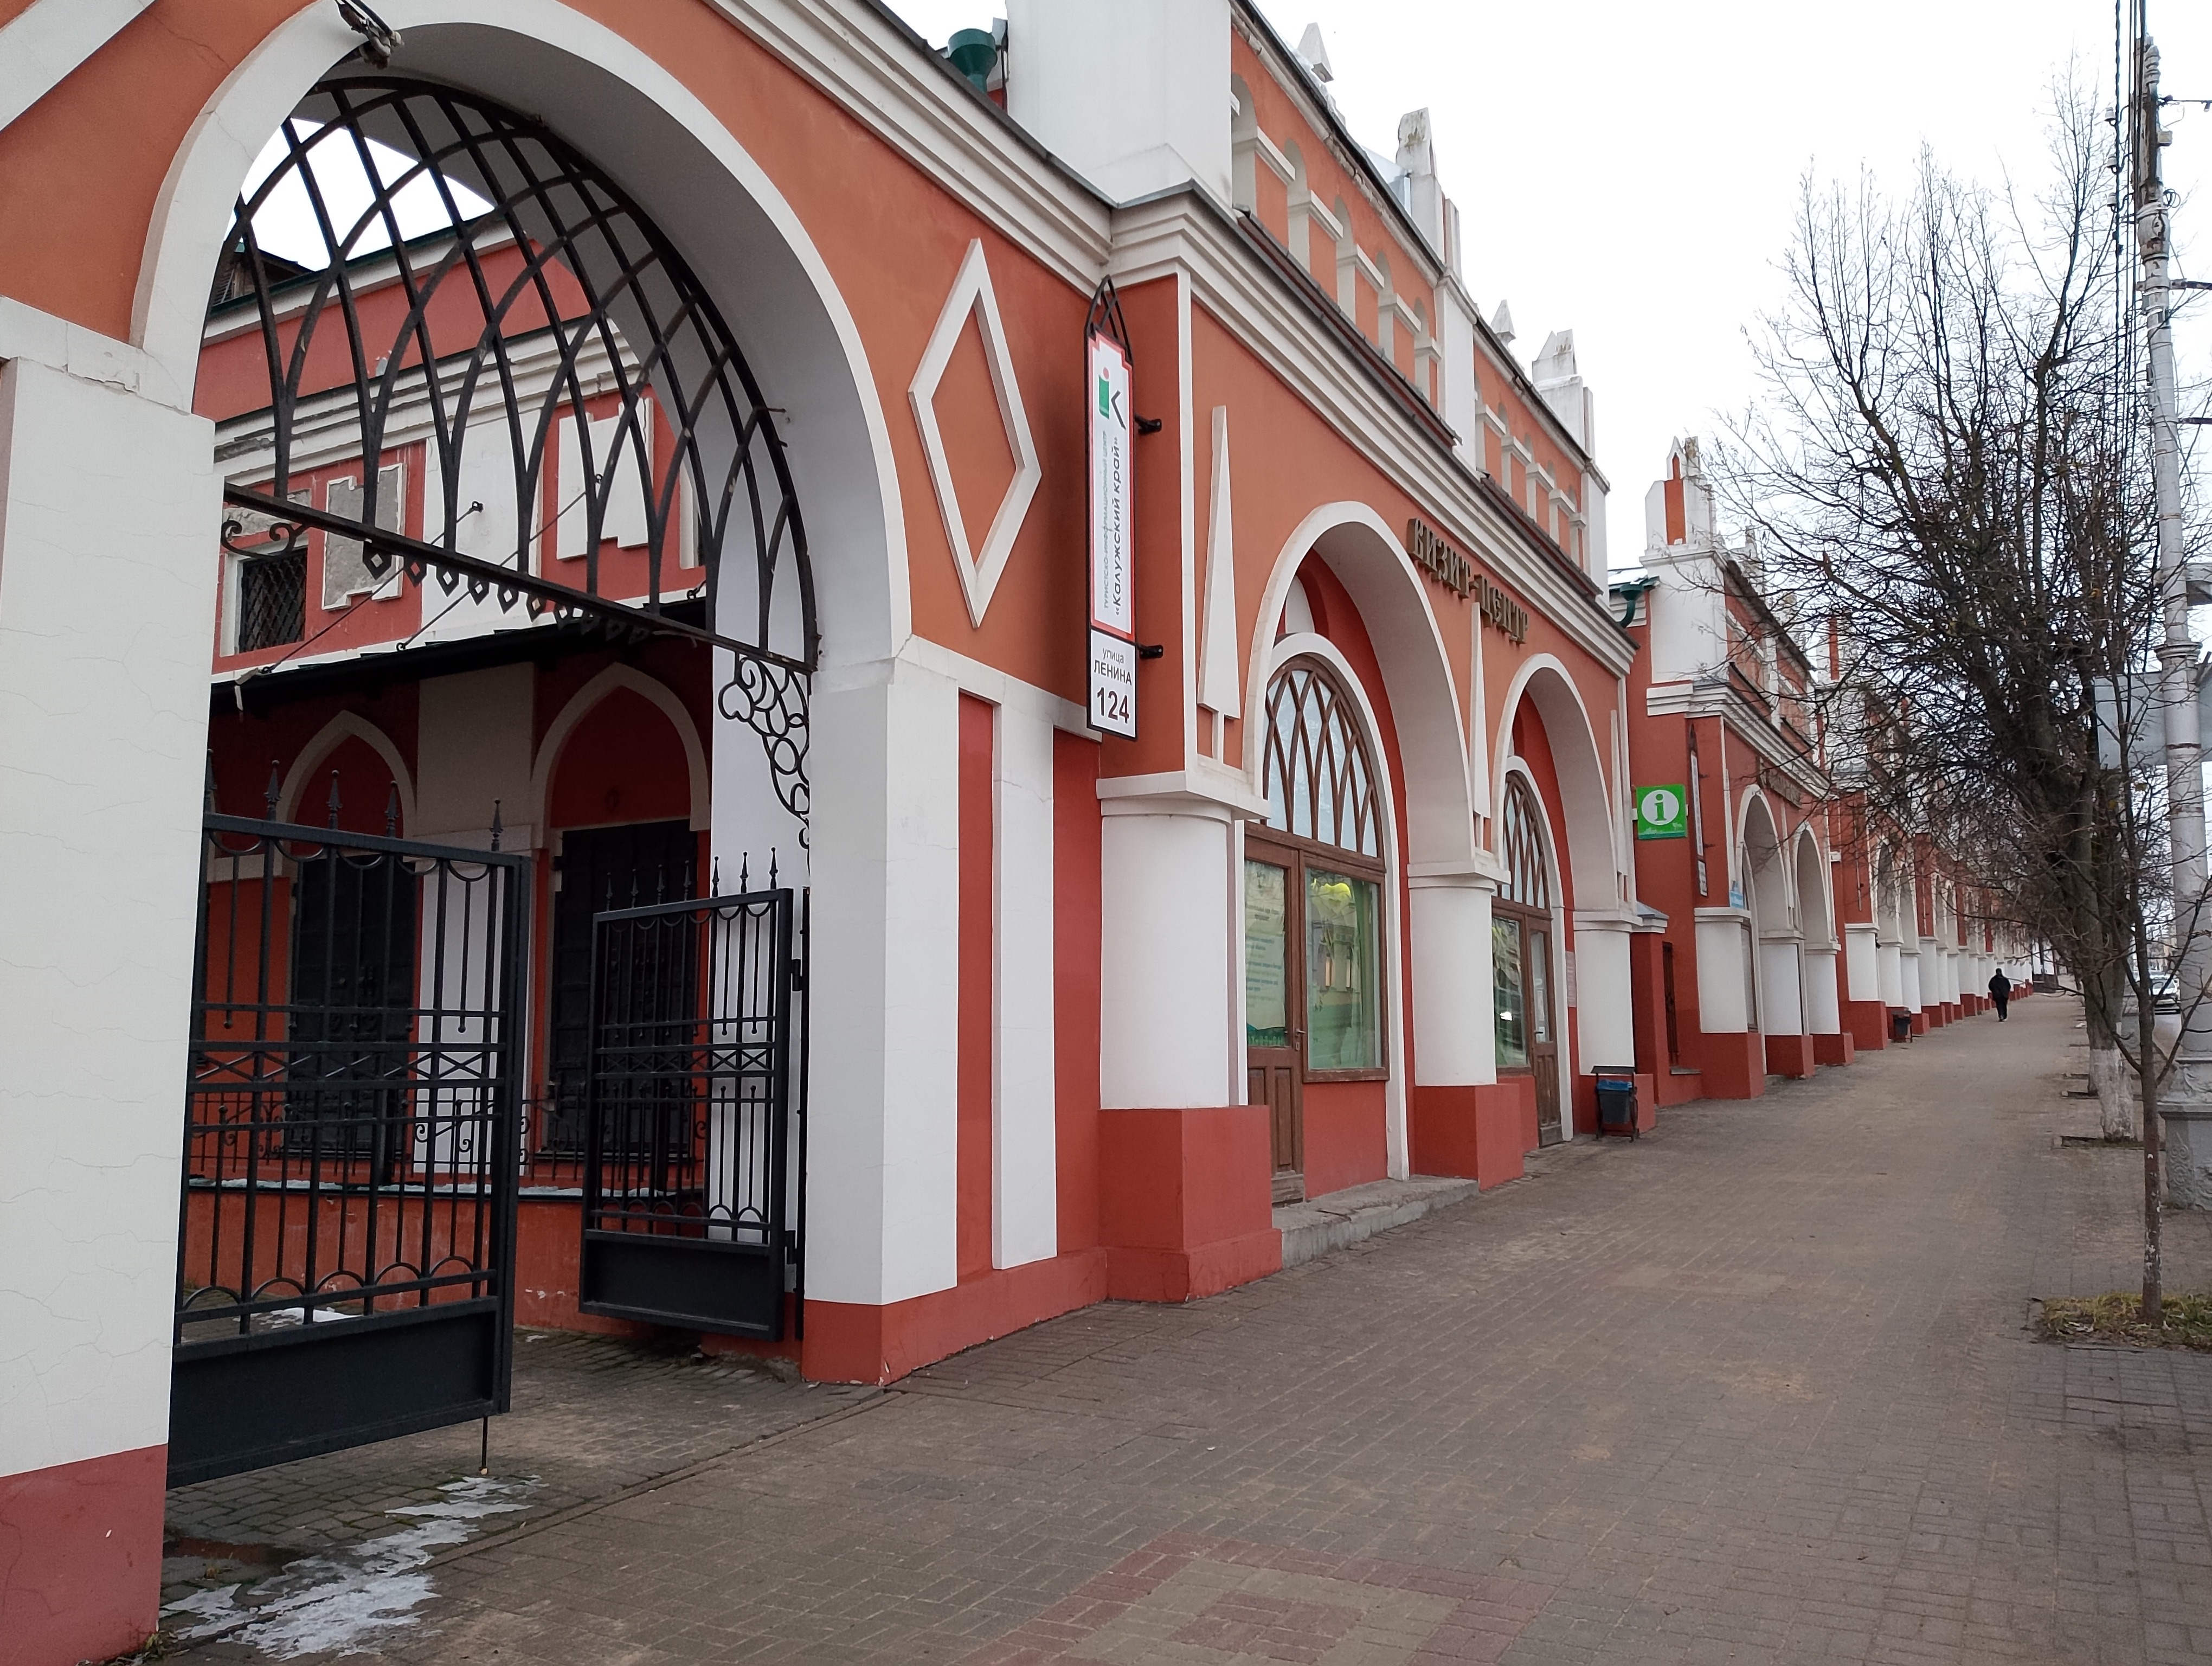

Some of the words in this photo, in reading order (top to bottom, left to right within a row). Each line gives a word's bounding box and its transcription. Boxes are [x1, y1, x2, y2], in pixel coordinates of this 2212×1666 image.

[1111, 437, 1121, 494] край»
[1111, 497, 1122, 616] «Калужский
[1094, 659, 1133, 686] ЛЕНИНА
[1103, 648, 1124, 665] улица
[1097, 687, 1129, 725] 124
